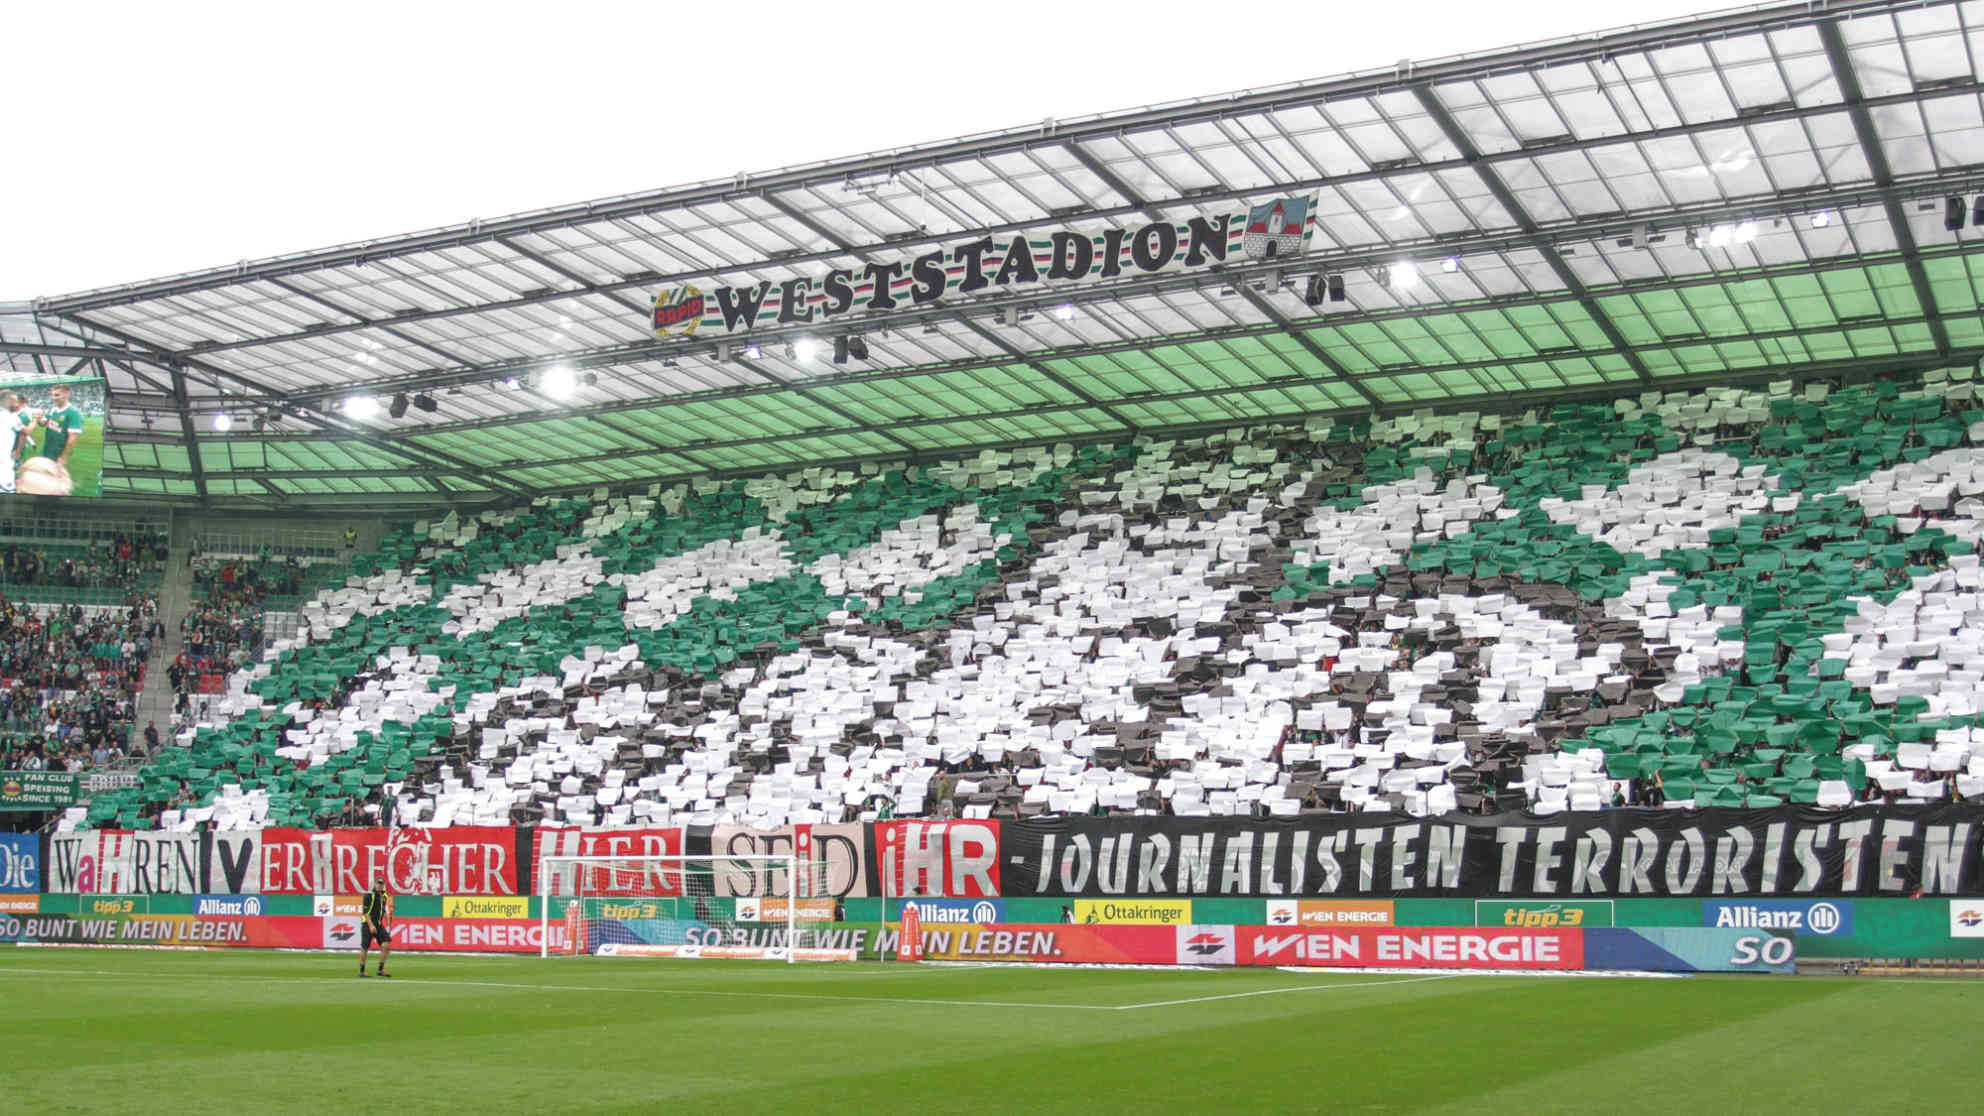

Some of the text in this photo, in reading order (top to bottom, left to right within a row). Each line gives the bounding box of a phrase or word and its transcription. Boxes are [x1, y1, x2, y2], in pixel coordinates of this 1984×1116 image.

[713, 213, 1233, 333] WESTSTADION
[24, 774, 74, 782] FAN CLUB
[22, 795, 51, 803] SINCE
[536, 830, 673, 896] HIER
[1035, 823, 1467, 895] JOURNALISTEN
[1496, 818, 1971, 895] TERRORISTEN
[93, 900, 134, 915] tipp3
[199, 897, 242, 914] Allianz
[464, 900, 523, 916] Ottakringer
[603, 903, 657, 920] tipp3
[1103, 903, 1183, 923] Ottakringer
[1503, 904, 1584, 927] tipp3
[1337, 911, 1388, 923] ENERGIE
[1716, 906, 1803, 928] Allianz
[25, 919, 77, 938] BUNT
[81, 920, 118, 939] WIE
[121, 920, 177, 940] MEIN
[178, 921, 248, 942] LEBEN.
[685, 926, 722, 947] SO
[814, 928, 868, 951] WIE
[872, 929, 951, 954] MIN
[958, 931, 1062, 955] LEBEN.
[1253, 933, 1560, 962] WIEN ENERGIE
[1730, 936, 1794, 965] SO
